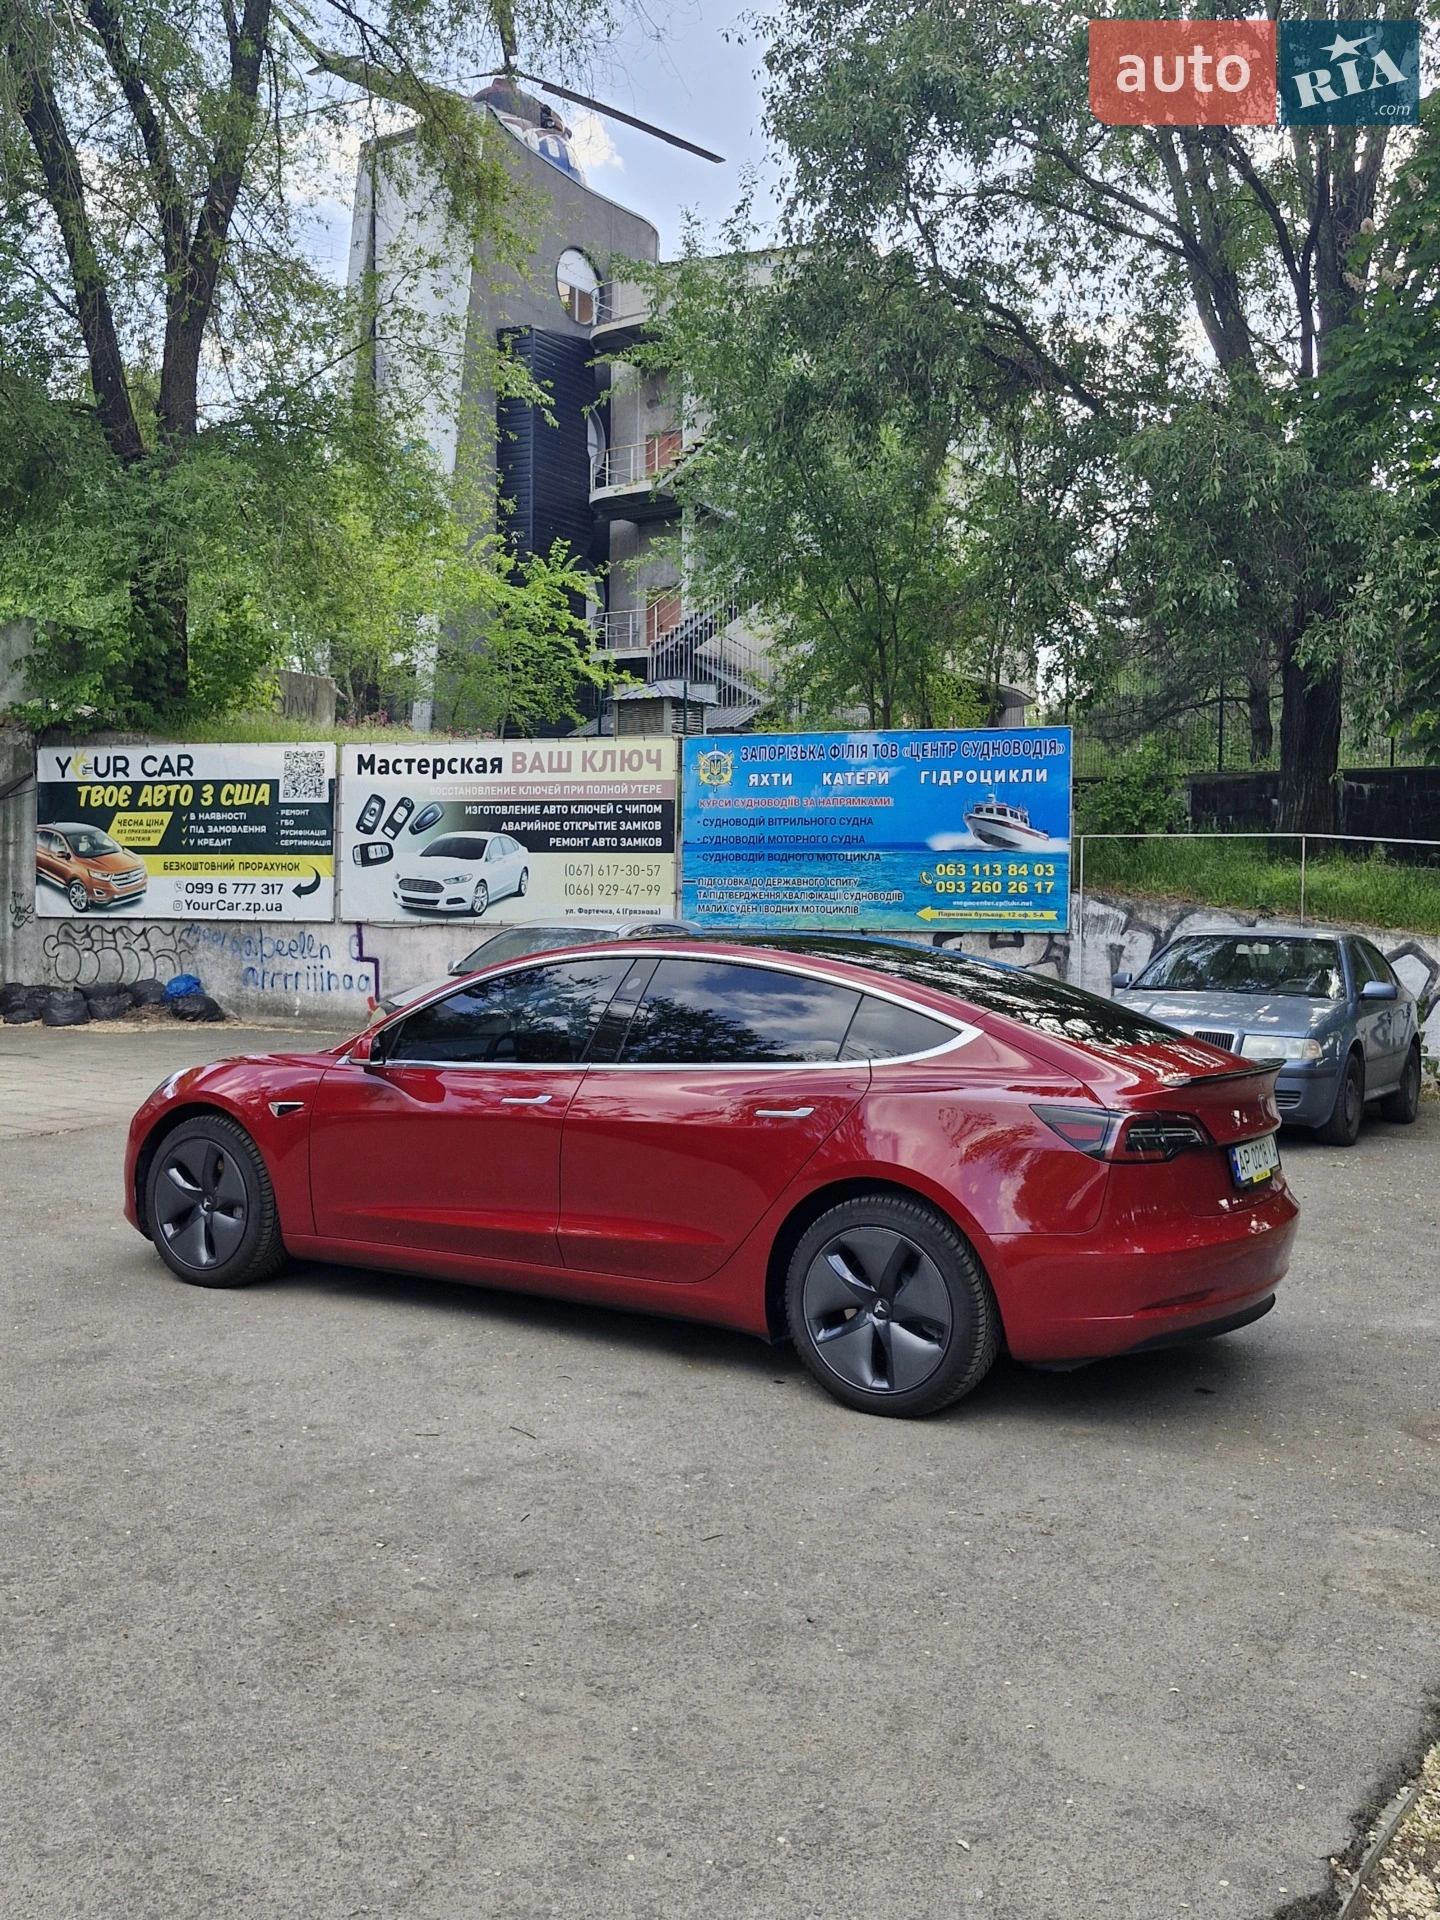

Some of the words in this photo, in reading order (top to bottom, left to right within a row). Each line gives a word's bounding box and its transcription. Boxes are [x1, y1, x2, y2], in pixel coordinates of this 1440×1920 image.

[741, 744, 825, 761] ЗАПОРІЗЬКА
[829, 743, 868, 760] ФІЛІЯ
[872, 743, 898, 759] ТОВ
[902, 741, 957, 762] «ЦЕНТР
[961, 739, 1065, 761] СУДНОВОДІЯ»
[141, 754, 194, 777] CAR
[357, 754, 503, 779] Мастерская
[512, 751, 572, 774] ВАШ
[582, 749, 662, 773] КЛЮЧ
[748, 773, 792, 786] ЯХТИ
[822, 771, 889, 785] КАТЕРИ
[920, 769, 1048, 786] ГІДРОЦИКЛИ
[77, 785, 132, 807] ТВОЄ
[138, 784, 194, 806] АВТО
[200, 784, 214, 806] З
[220, 783, 270, 806] США
[430, 785, 516, 796] ВОССТАНОВЛЕНИЕ
[519, 783, 561, 795] КЛЮЧЕЙ
[563, 784, 584, 795] ПРИ
[587, 783, 628, 795] ПОЛНОЙ
[631, 784, 662, 794] УТЕРЕ
[699, 798, 731, 807] КУРСИ
[803, 797, 816, 807] ЗА
[465, 805, 541, 815] ИЗГОТОВЛЕНИЕ
[542, 804, 568, 815] АВТО
[570, 803, 614, 815] КЛЮЧЕЙ
[616, 804, 623, 814] С
[625, 804, 662, 814] ЧИПОМ
[198, 812, 247, 820] НАЯВНОСТІ
[703, 816, 766, 828] СУДНОВОДІЙ
[768, 817, 836, 827] ВІТРИЛЬНОГО
[839, 817, 873, 828] СУДНА
[117, 819, 144, 827] ЧЕСНА
[146, 819, 164, 829] ЦІНА
[190, 826, 205, 834] ПІД
[207, 825, 267, 833] ЗАМОВЛЕННЯ
[501, 819, 561, 831] АВАРИЙНОЕ
[562, 821, 617, 831] ОТКРЫТИЕ
[619, 821, 662, 831] ЗАМКОВ
[280, 829, 327, 837] РУСИФІКАЦІЯ
[702, 833, 766, 845] СУДНОВОДІЙ
[767, 835, 828, 845] МОТОРНОГО
[831, 835, 865, 845] СУДНА
[190, 838, 195, 846] У
[198, 838, 232, 847] КРЕДИТ
[549, 838, 589, 847] РЕМОНТ
[591, 838, 618, 847] АВТО
[619, 838, 662, 847] ЗАМКОВ
[702, 851, 766, 863] СУДНОВОДІЙ
[767, 853, 813, 863] ВОДНОГО
[816, 853, 881, 863] МОТОЦИКЛА
[163, 859, 235, 871] БЕЗКОШТОВНИЙ
[239, 862, 300, 871] ПРОРАХУНОК
[564, 863, 594, 877] (067)
[597, 864, 661, 877] 617-30-57
[936, 864, 966, 876] 063
[972, 864, 1002, 876] 113
[1007, 864, 1028, 876] 84
[1034, 864, 1055, 876] 03
[185, 882, 214, 894] 099
[218, 883, 227, 894] 6
[231, 883, 256, 894] 777
[261, 883, 284, 895] 317
[697, 878, 749, 887] ПІДГОТОВКА
[751, 878, 764, 887] ДО
[765, 878, 825, 887] ДЕРЖАВНОГО
[827, 878, 858, 887] ІСПИТУ
[935, 881, 966, 893] 093
[971, 881, 1002, 893] 260
[1007, 881, 1028, 893] 26
[1034, 881, 1055, 893] 17
[564, 883, 594, 896] (066)
[597, 884, 661, 896] 929-47-99
[697, 891, 707, 899] ТА
[709, 891, 781, 900] ПІДТВЕРДЖЕННЯ
[185, 899, 283, 914] YourCar.zp.ua
[577, 907, 615, 916] Фортечна,
[622, 908, 661, 916] (Грязнова)
[697, 905, 727, 913] МАЛИХ
[729, 905, 758, 914] СУДЕН
[764, 905, 799, 914] ВОДНИХ
[801, 905, 859, 914] МОТОЦИКЛІВ
[1238, 1149, 1250, 1175] AP
